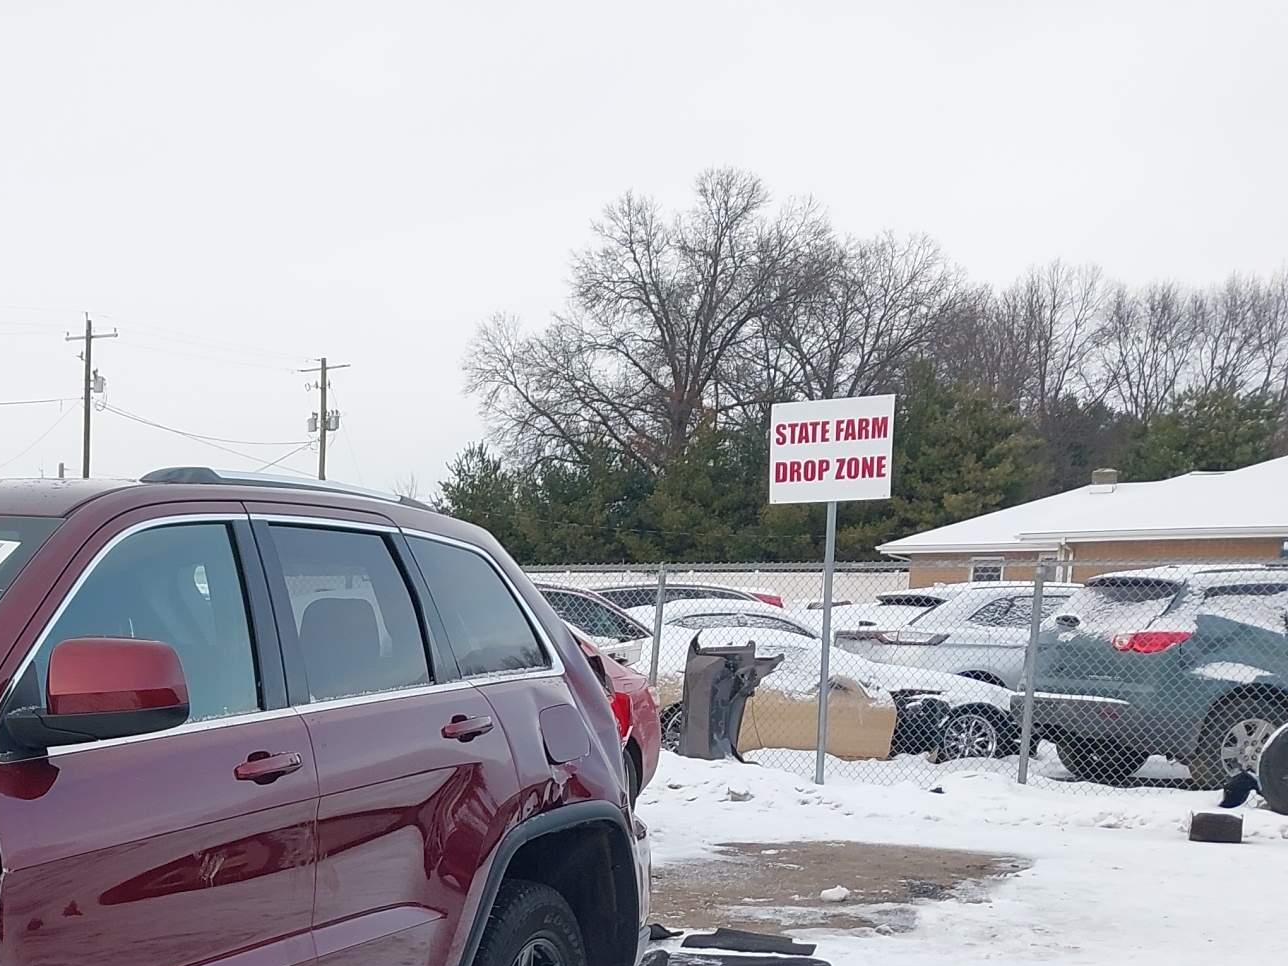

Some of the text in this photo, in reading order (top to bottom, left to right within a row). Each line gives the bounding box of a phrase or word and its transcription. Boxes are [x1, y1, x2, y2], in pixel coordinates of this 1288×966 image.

[775, 416, 889, 446] STATE FARM
[775, 455, 887, 483] DROP ZONE
